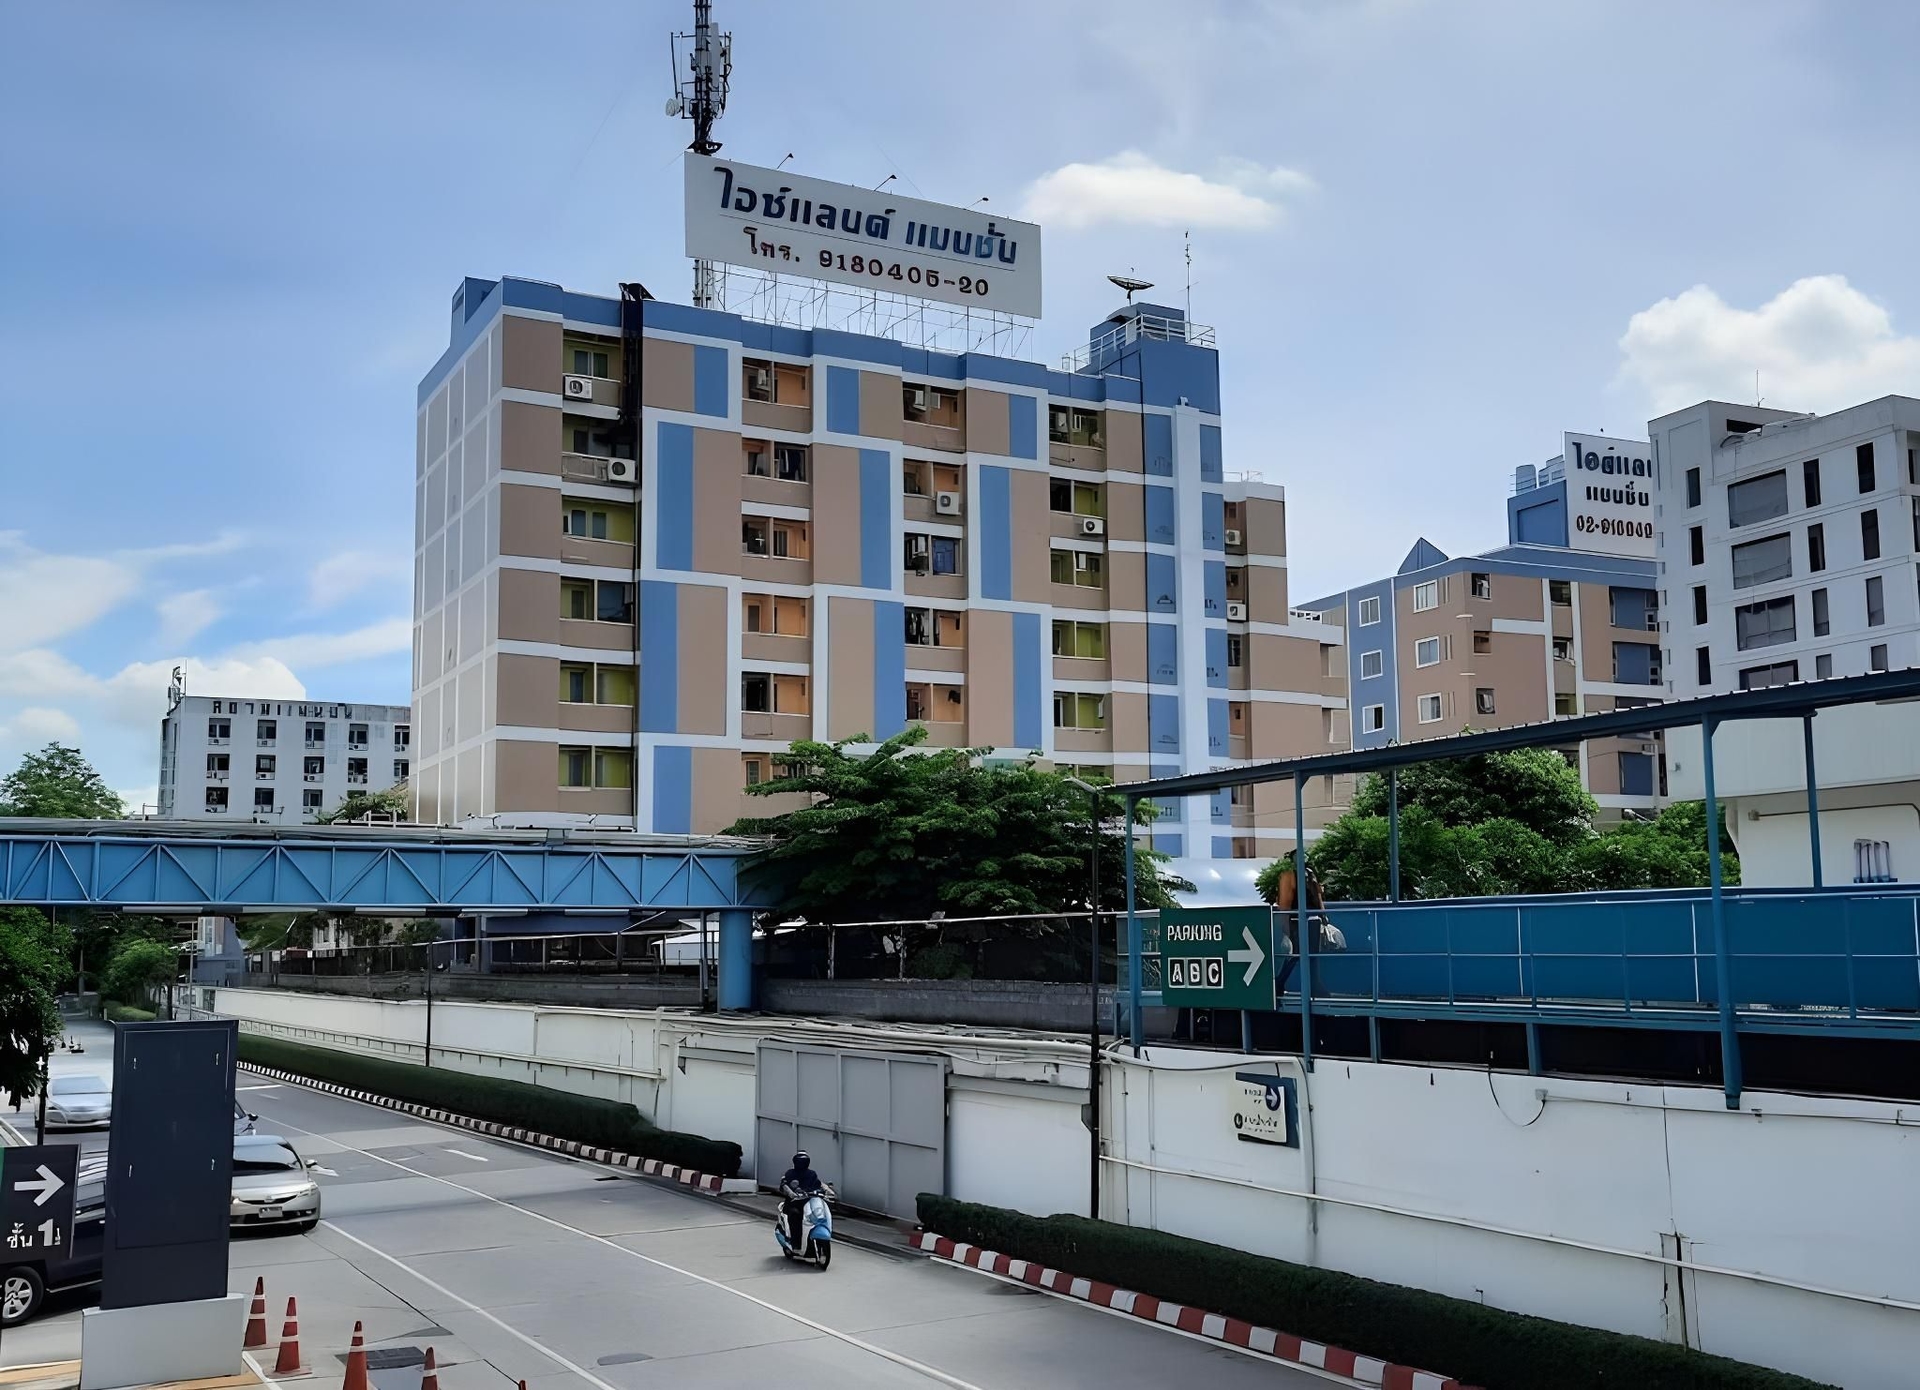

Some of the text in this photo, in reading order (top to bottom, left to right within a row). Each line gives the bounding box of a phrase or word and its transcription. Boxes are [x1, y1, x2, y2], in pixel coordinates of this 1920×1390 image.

[905, 221, 1017, 264] แมนชั่น
[819, 250, 989, 296] 9180405-20
[1167, 924, 1223, 941] PARKING
